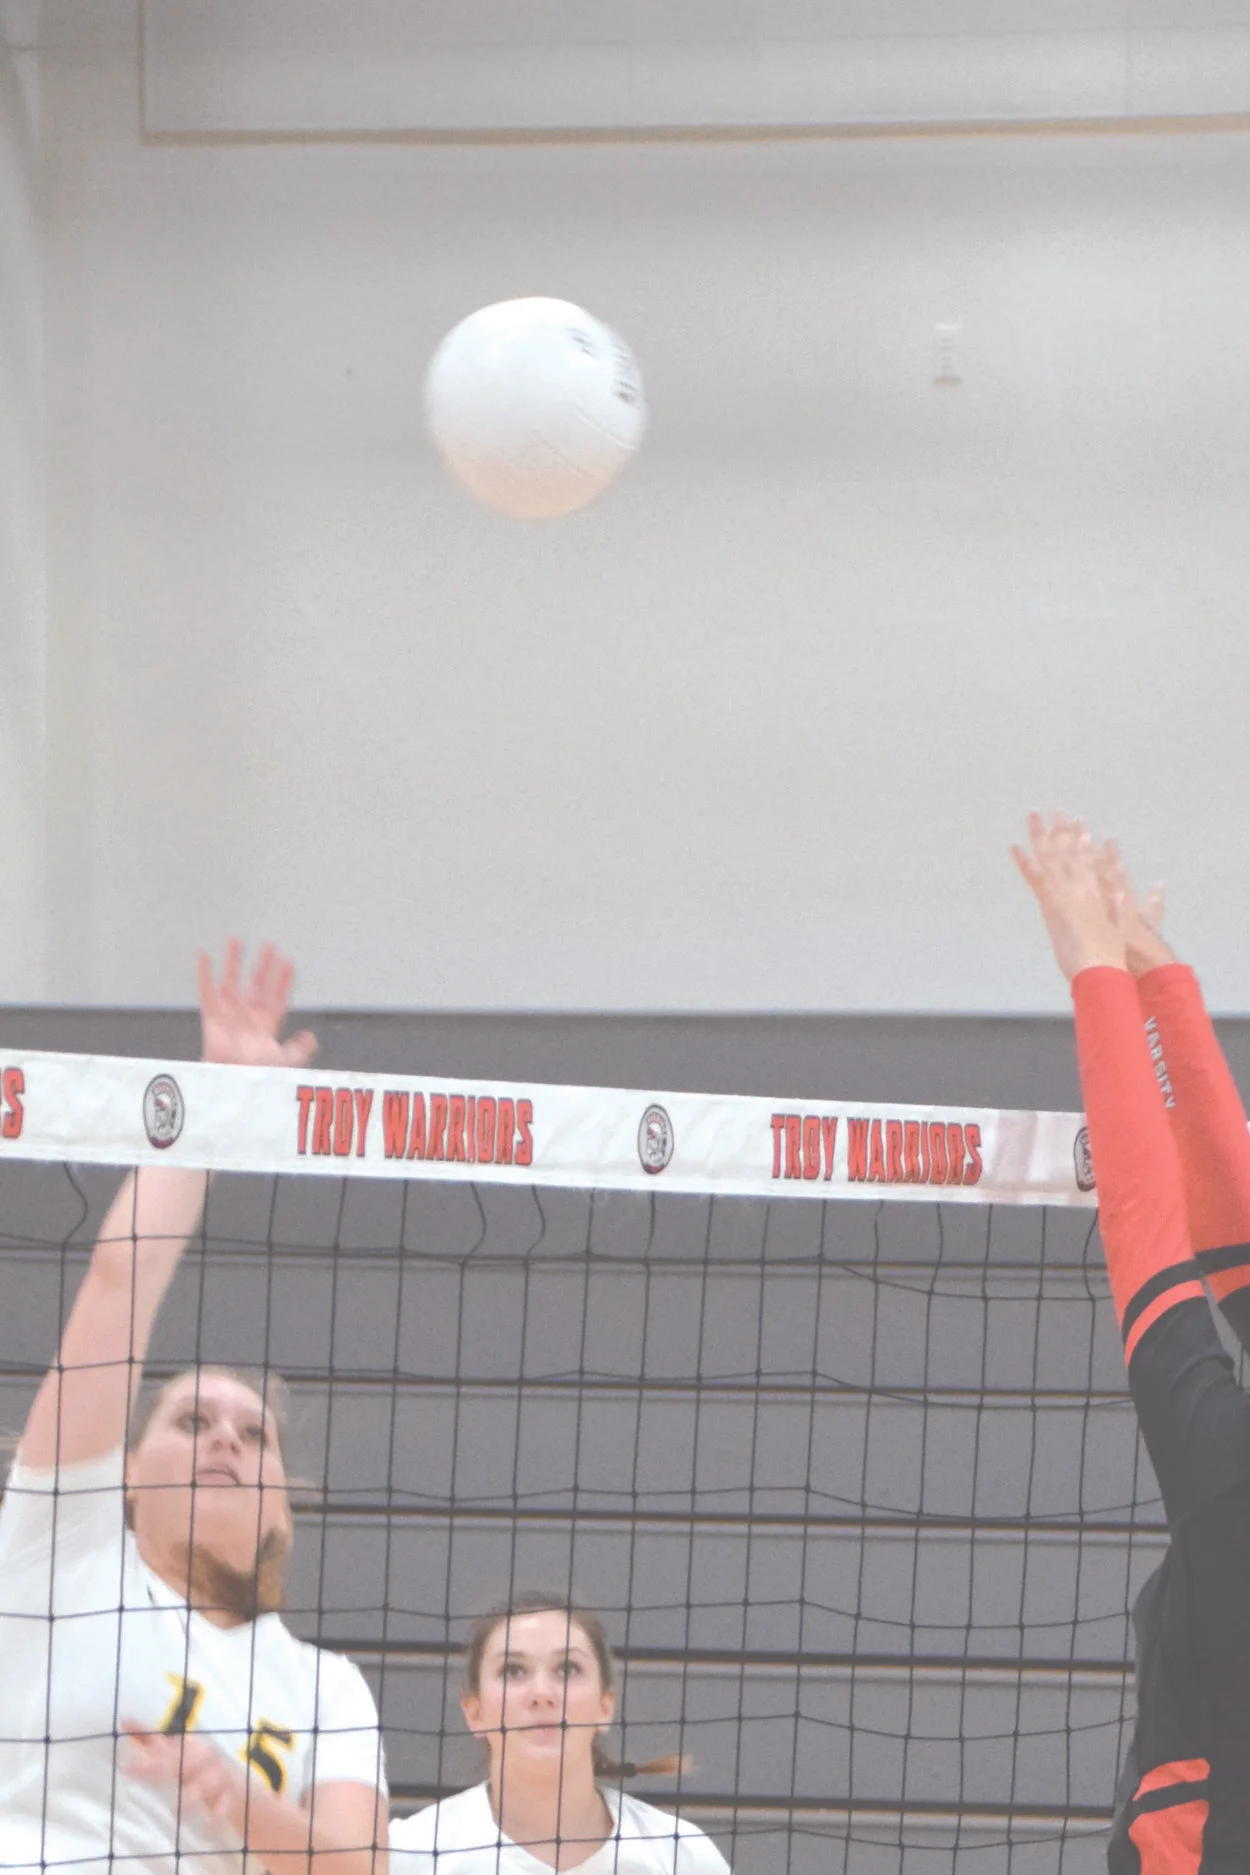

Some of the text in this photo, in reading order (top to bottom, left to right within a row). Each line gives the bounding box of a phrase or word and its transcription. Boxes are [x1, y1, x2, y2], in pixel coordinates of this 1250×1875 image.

[1144, 1015, 1176, 1109] VARSITY
[297, 1085, 534, 1166] TROY WARRIORS
[771, 1113, 983, 1185] TROY WARRIORS
